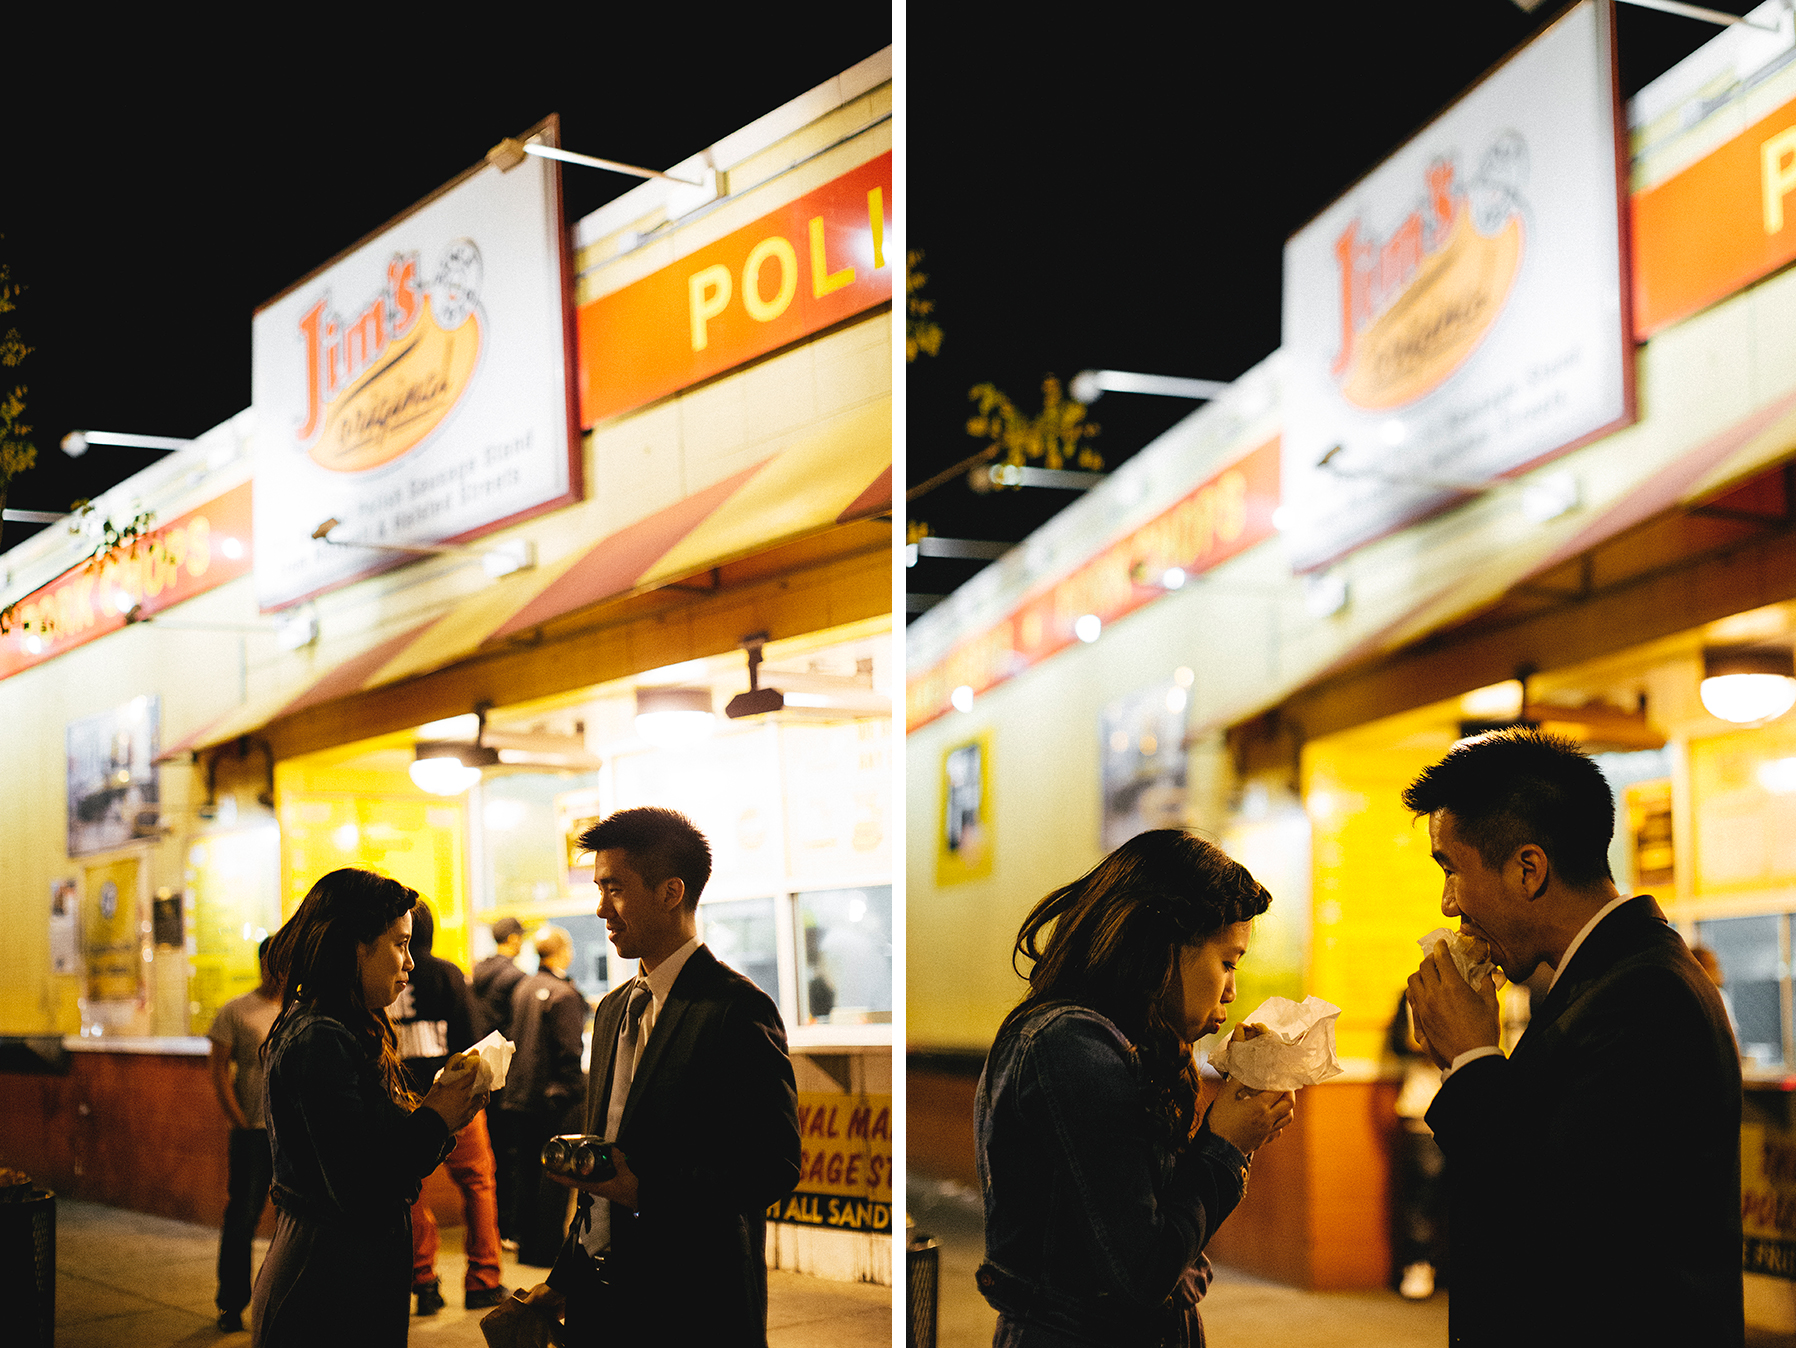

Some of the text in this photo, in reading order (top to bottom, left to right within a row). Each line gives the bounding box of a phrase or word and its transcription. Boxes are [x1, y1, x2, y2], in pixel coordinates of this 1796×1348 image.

[688, 186, 886, 353] POLI
[297, 256, 417, 442] Jim's
[847, 1106, 892, 1141] MA
[783, 1195, 824, 1224] ALL
[827, 1197, 892, 1230] SAND
